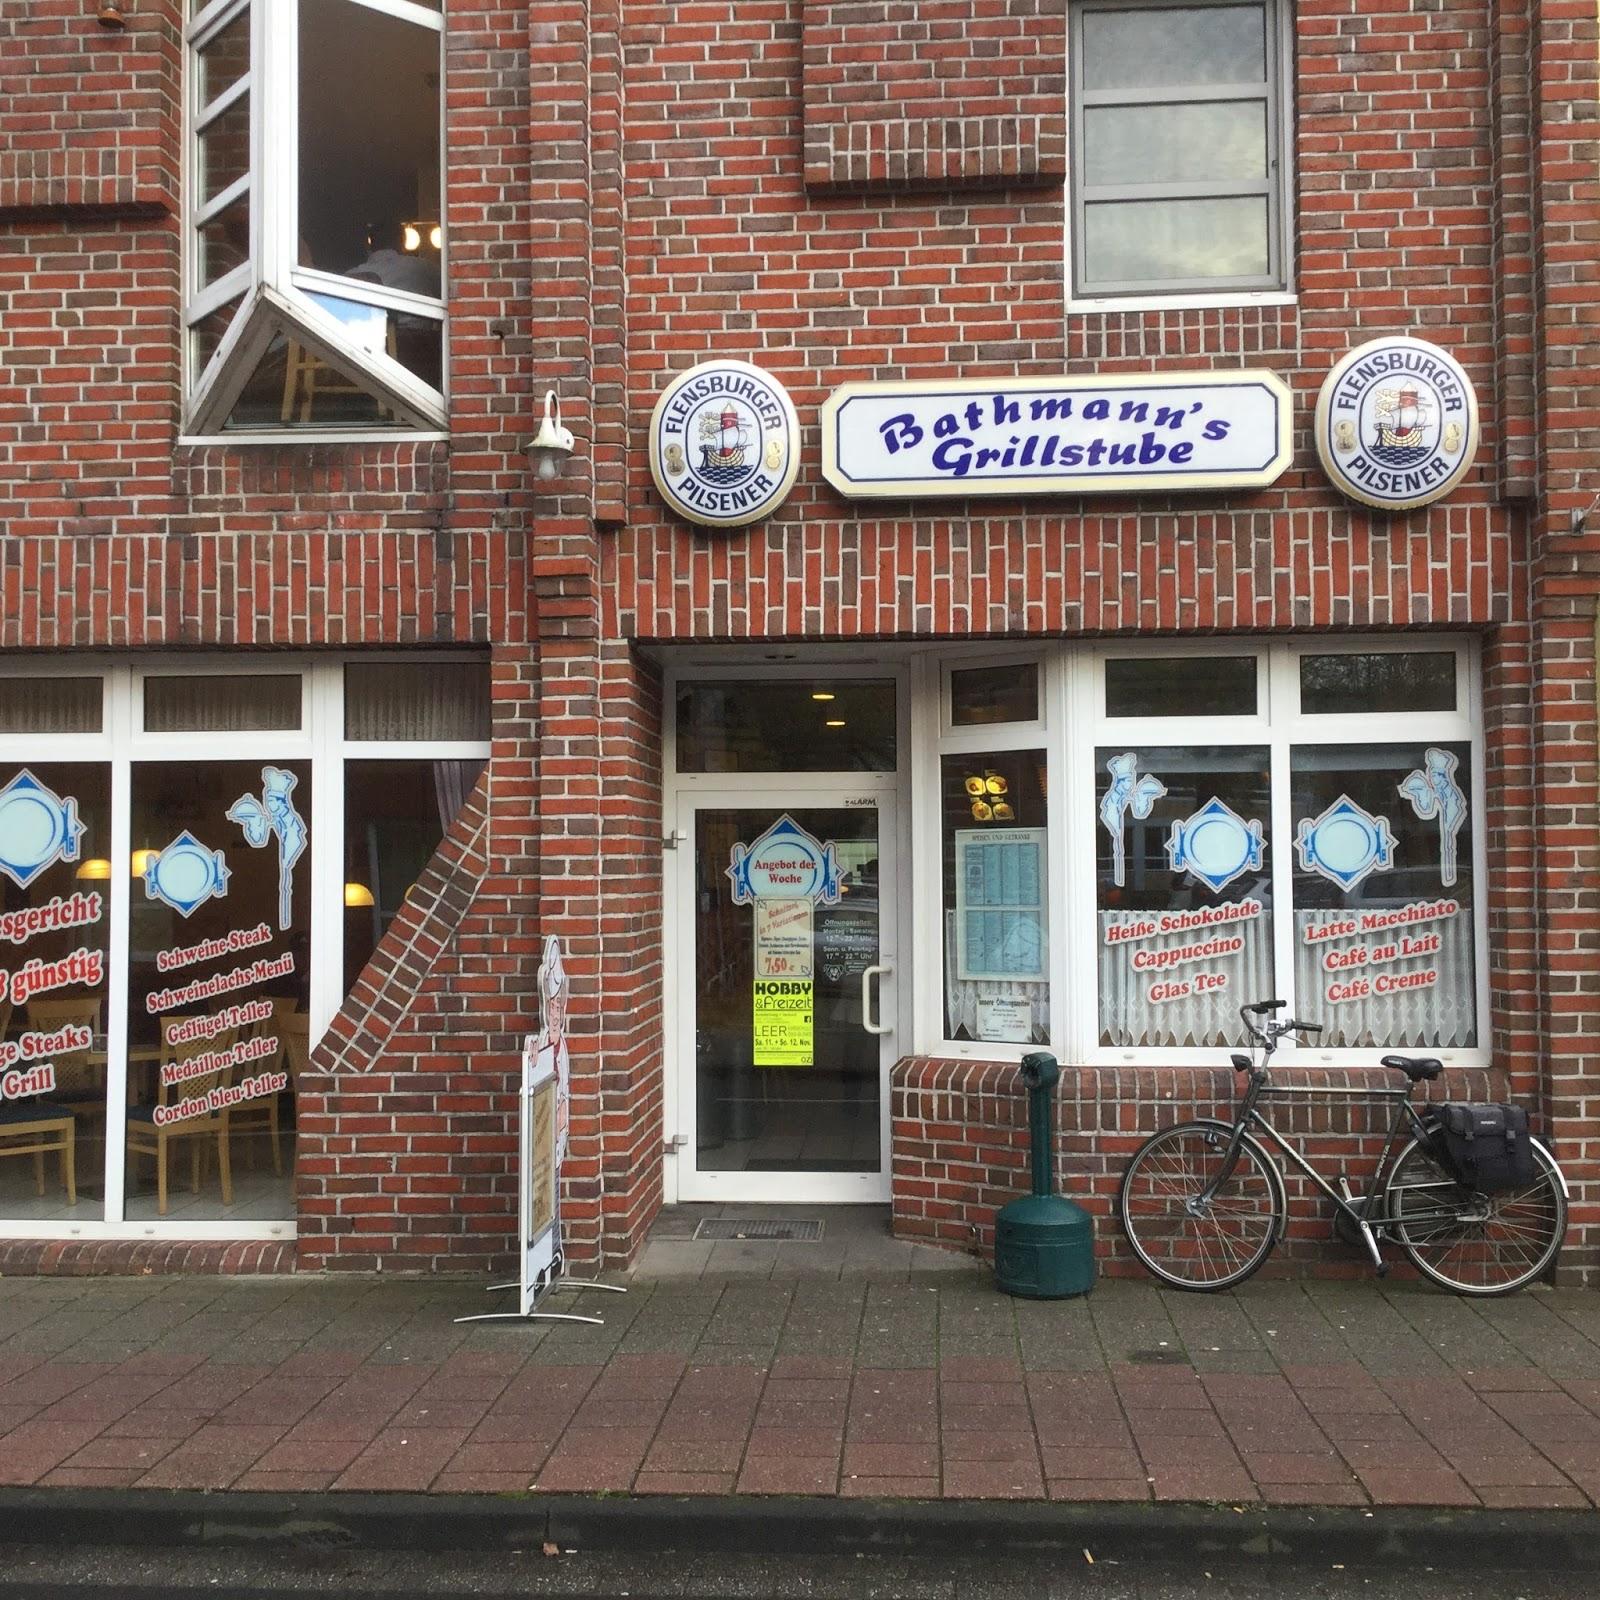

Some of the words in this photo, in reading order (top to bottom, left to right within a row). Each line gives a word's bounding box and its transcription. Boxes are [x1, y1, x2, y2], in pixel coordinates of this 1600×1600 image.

[1338, 353, 1462, 412] FLENSBURGER
[666, 376, 781, 433] FLENSBURGER
[879, 395, 1231, 454] Bathmann's
[932, 432, 1194, 476] Grillstube
[1346, 455, 1450, 492] PILSENER
[678, 474, 773, 511] PILSENER
[754, 859, 796, 871] Angebot
[799, 859, 816, 869] der
[769, 874, 802, 883] Woche
[1108, 921, 1155, 941] Heiße
[1161, 901, 1260, 931] Schokolade
[1307, 921, 1355, 940] Latte
[1361, 902, 1456, 930] Macchiato
[158, 924, 271, 969] Schweine-Steak
[1134, 938, 1242, 968] Cappuccino
[1326, 946, 1367, 968] Café
[1372, 945, 1396, 960] au
[1402, 934, 1439, 955] Lait
[13, 951, 101, 1002] günstig
[148, 954, 293, 1011] Schweinelachs-Menü
[755, 982, 812, 995] HOBBY
[1151, 981, 1189, 1001] Glas
[1195, 974, 1226, 991] Tee
[1328, 978, 1370, 1001] Café
[1375, 970, 1436, 992] Creme
[168, 1002, 272, 1043] Geflügel-Teller
[755, 1025, 787, 1036] LEER
[23, 1028, 89, 1057] Steaks
[163, 1039, 277, 1084] Medaillon-Teller
[5, 1067, 52, 1095] Grill
[155, 1097, 207, 1124] Cordon
[211, 1074, 286, 1108] bleu-Teller
